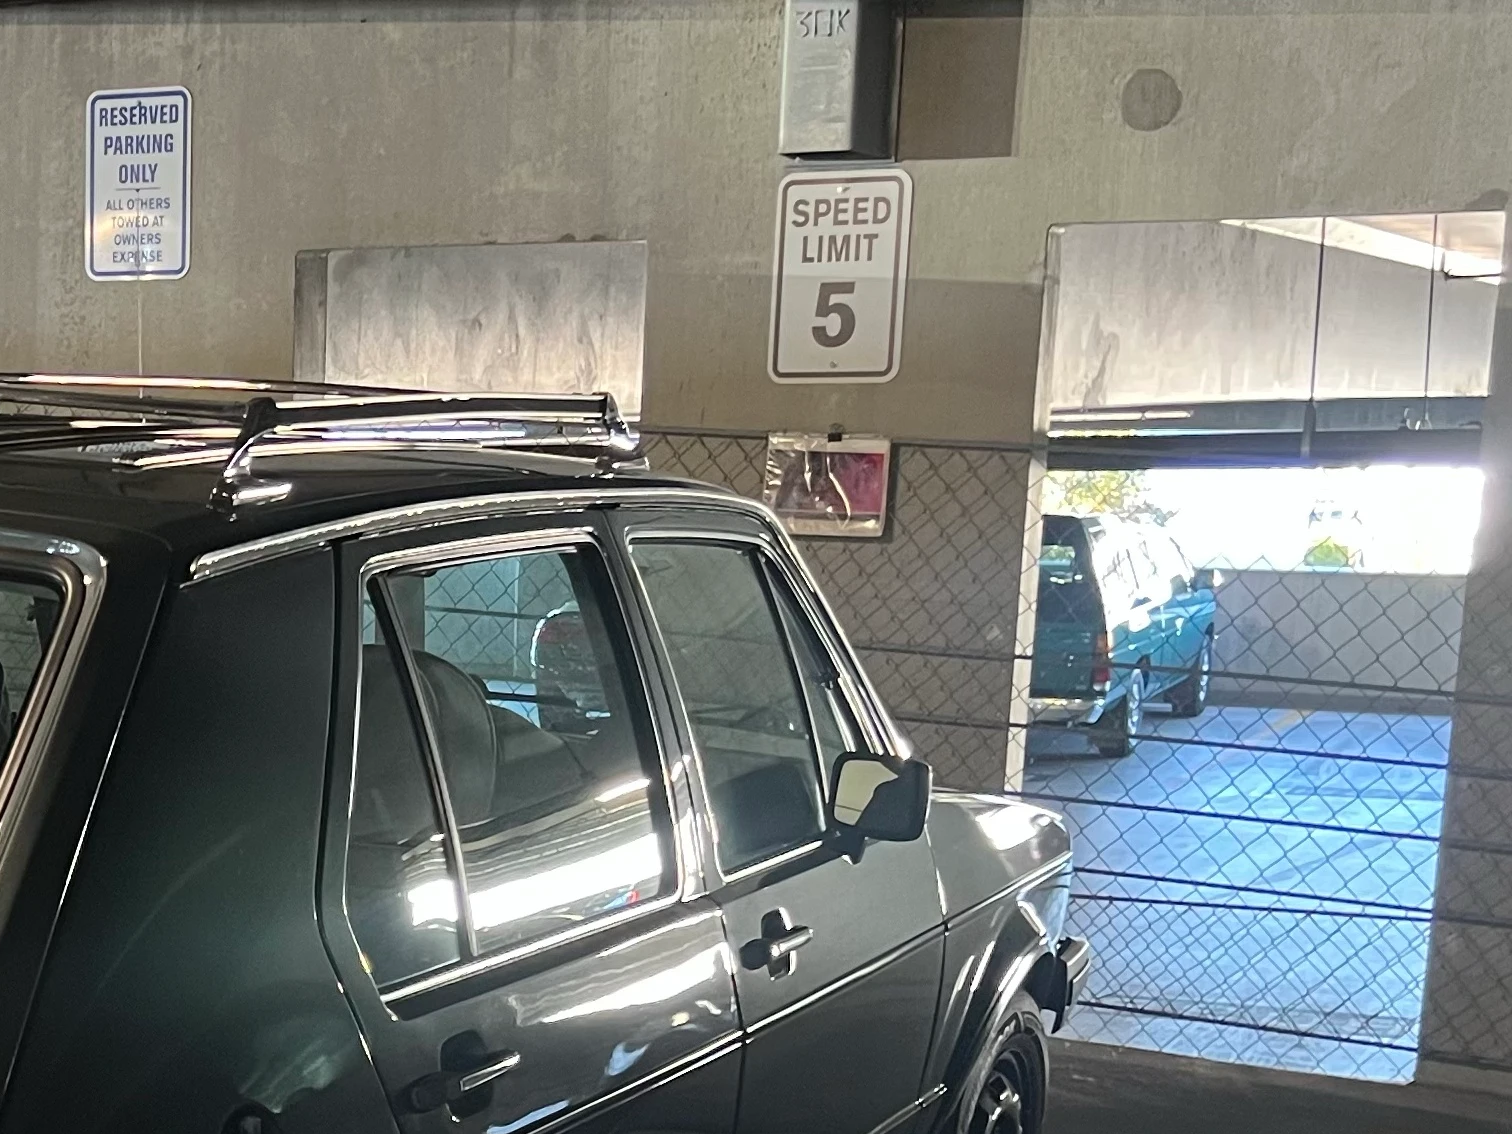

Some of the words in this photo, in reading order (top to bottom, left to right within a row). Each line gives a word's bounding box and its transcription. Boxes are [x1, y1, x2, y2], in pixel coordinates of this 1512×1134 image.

[99, 103, 179, 127] RESERVED
[103, 133, 174, 156] PARKING
[118, 162, 158, 184] ONLY
[105, 198, 124, 211] ALL
[126, 197, 171, 211] OTHERS
[791, 196, 892, 228] SPEED
[111, 215, 149, 229] TOWED
[151, 215, 165, 227] AT
[114, 232, 162, 246] OWNERS
[800, 232, 880, 264] LIMIT
[810, 281, 857, 349] 5
